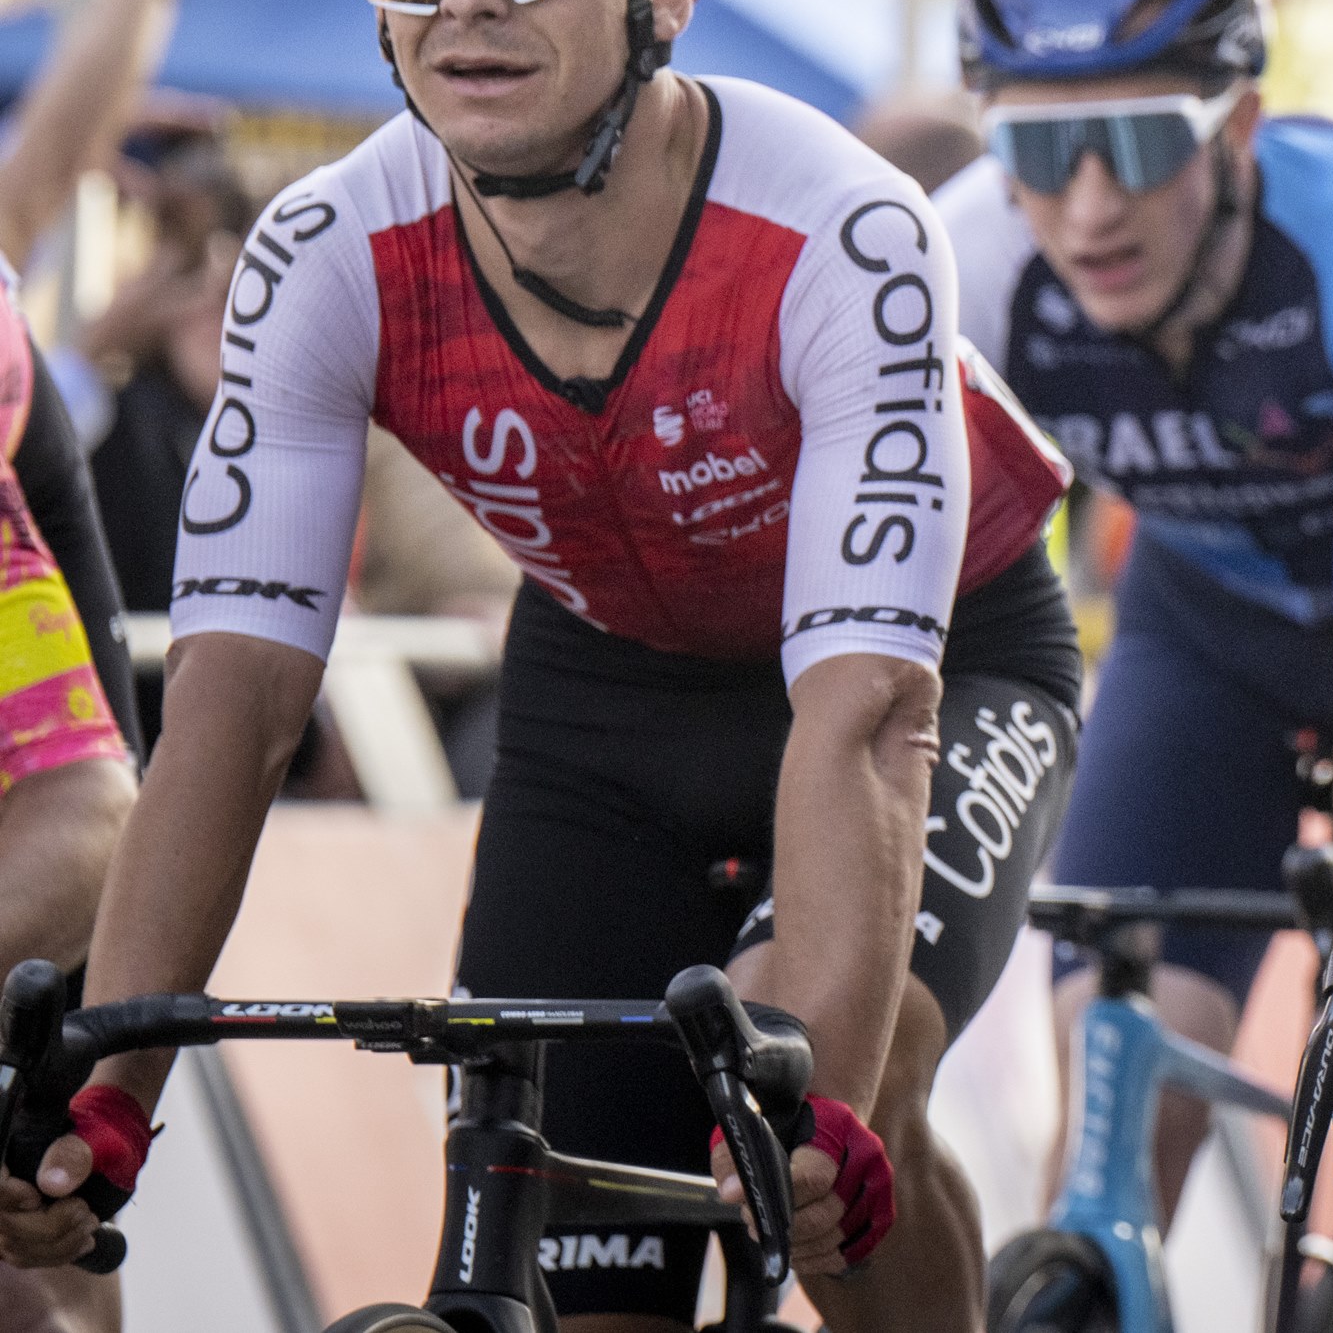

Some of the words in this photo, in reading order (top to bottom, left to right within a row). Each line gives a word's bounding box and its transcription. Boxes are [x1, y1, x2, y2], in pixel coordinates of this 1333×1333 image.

[838, 199, 945, 566] Cofidis
[924, 701, 1057, 899] Cofidis
[459, 1184, 481, 1285] LOOK
